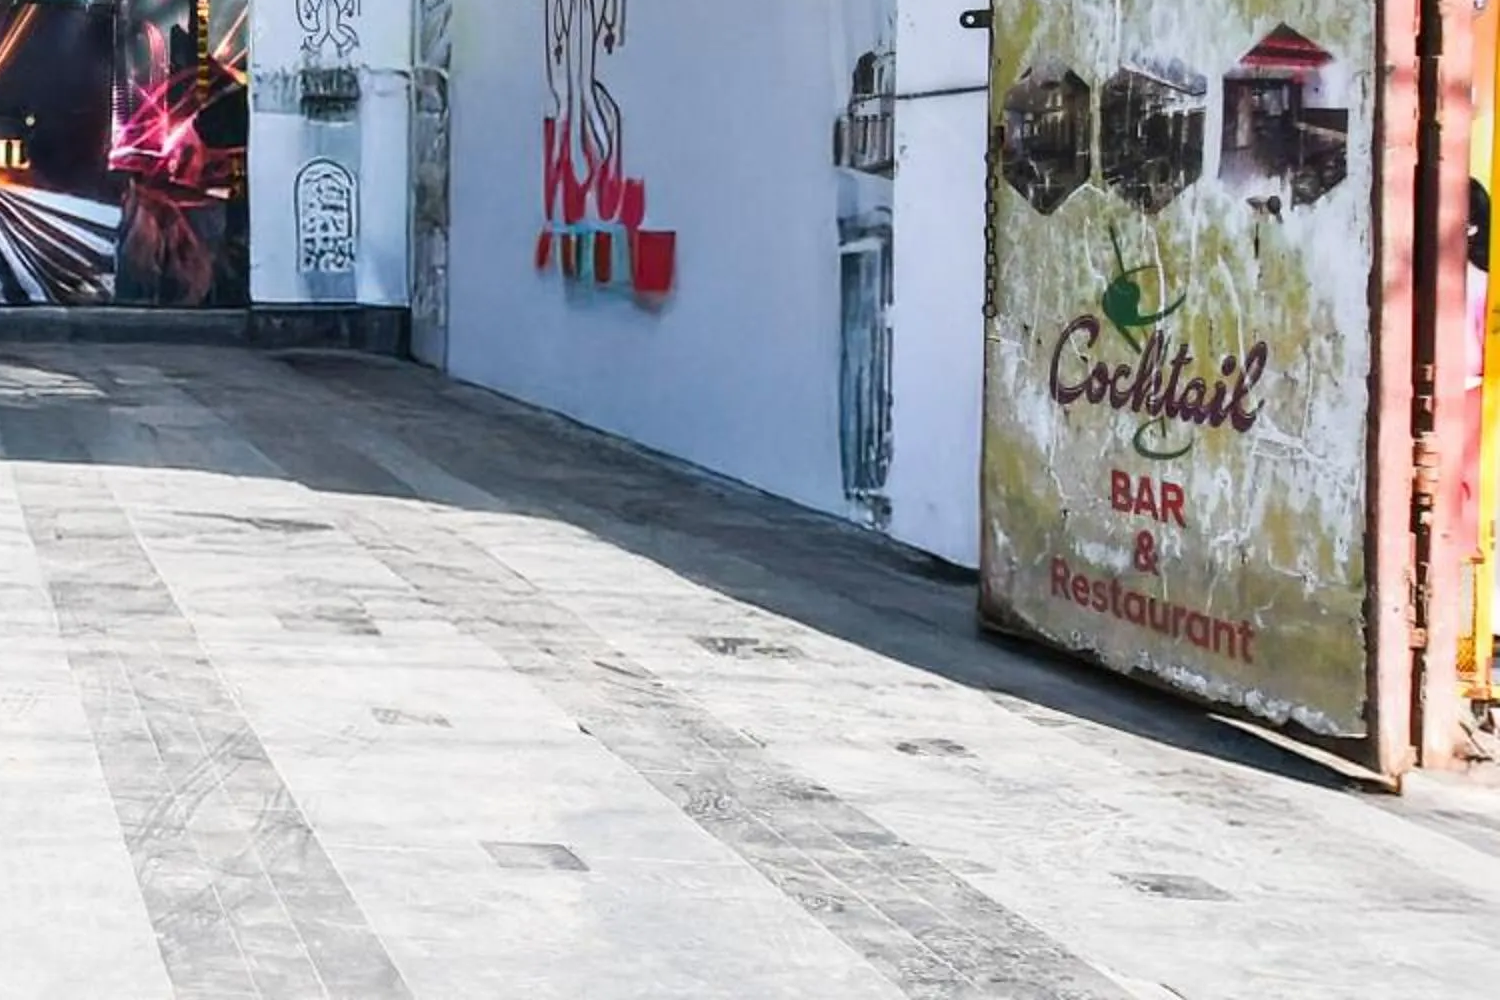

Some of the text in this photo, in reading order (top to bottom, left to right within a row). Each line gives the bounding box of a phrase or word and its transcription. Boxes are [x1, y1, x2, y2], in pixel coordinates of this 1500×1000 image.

[1049, 313, 1268, 432] Cocktail
[1110, 469, 1187, 528] BAR
[1133, 530, 1159, 576] &
[1050, 557, 1256, 663] Restaurant
